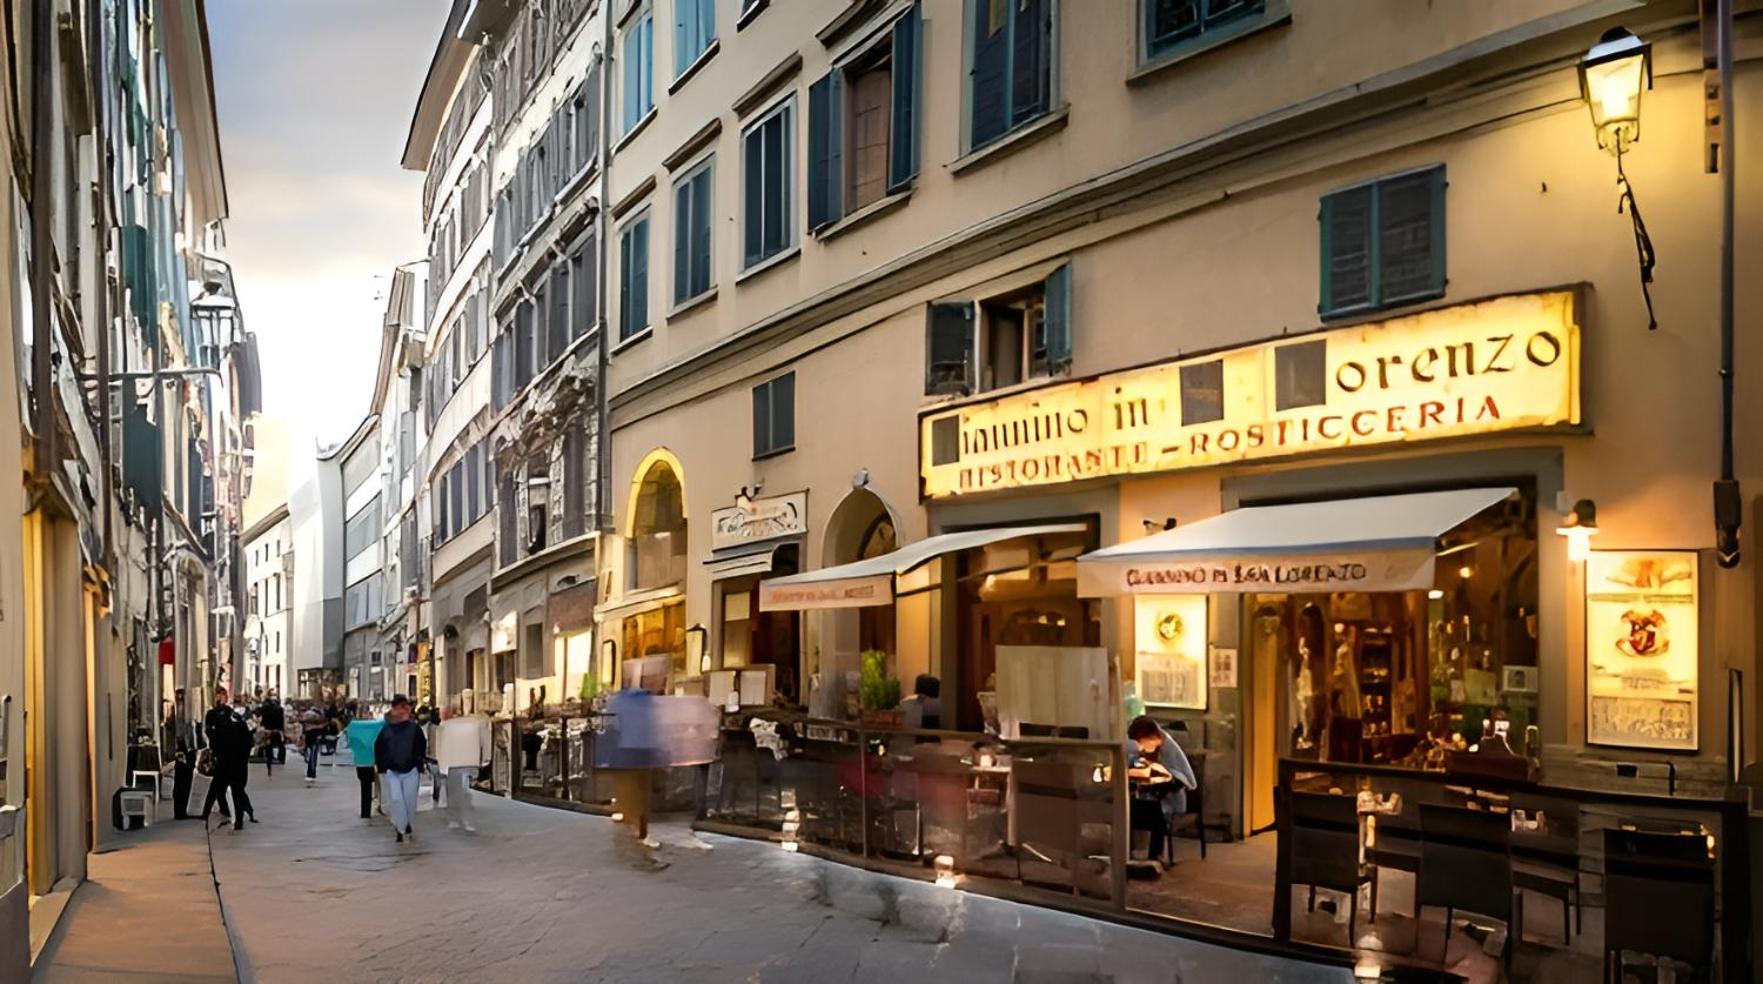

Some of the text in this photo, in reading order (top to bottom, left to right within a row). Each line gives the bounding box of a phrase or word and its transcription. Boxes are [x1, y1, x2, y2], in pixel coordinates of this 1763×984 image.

[1114, 397, 1149, 430] in
[1275, 331, 1561, 406] orenzo
[1190, 395, 1500, 455] ROSTICCERIA
